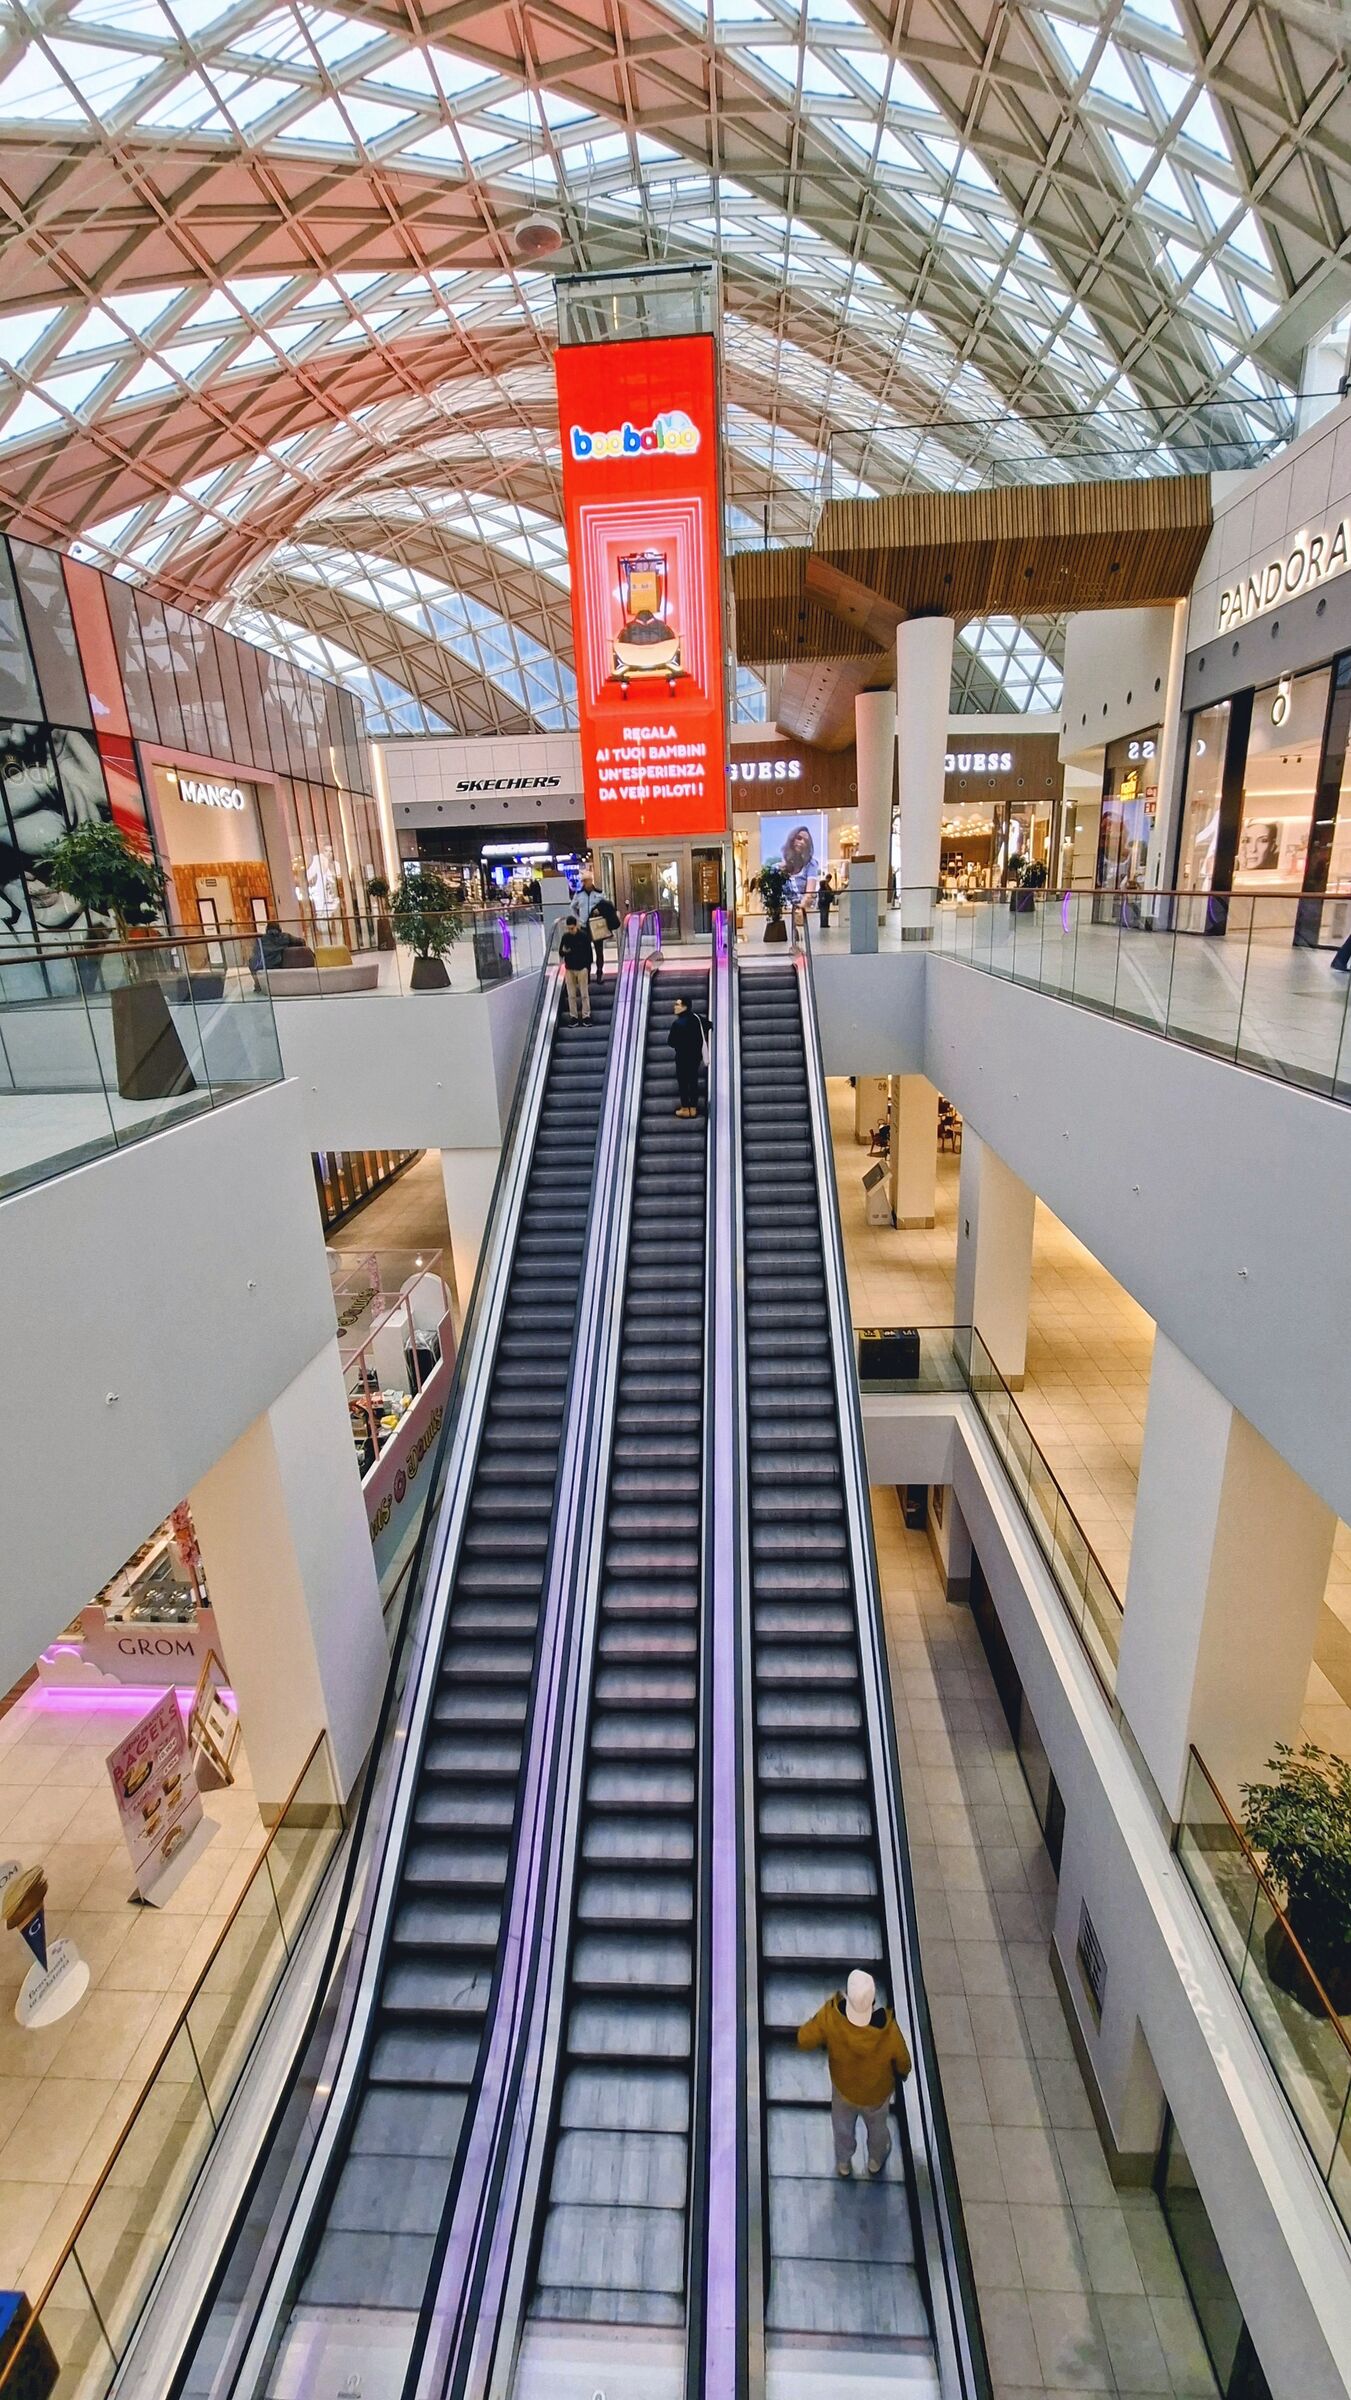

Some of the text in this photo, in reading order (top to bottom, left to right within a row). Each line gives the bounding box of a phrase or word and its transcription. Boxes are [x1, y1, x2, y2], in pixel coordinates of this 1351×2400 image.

[571, 415, 699, 458] boobaloo
[1218, 520, 1350, 631] PANDORA
[623, 726, 677, 740] REGALA
[596, 743, 706, 762] AI TUOI BAMBINI
[598, 763, 705, 781] UN'ESPERIENZA
[456, 775, 561, 793] SKECHERS
[599, 787, 618, 800] DA
[619, 785, 649, 800] VERI
[652, 783, 696, 799] PILOTI
[180, 779, 244, 811] MANGO
[118, 1638, 195, 1656] GROM
[112, 1703, 178, 1784] BAGELS
